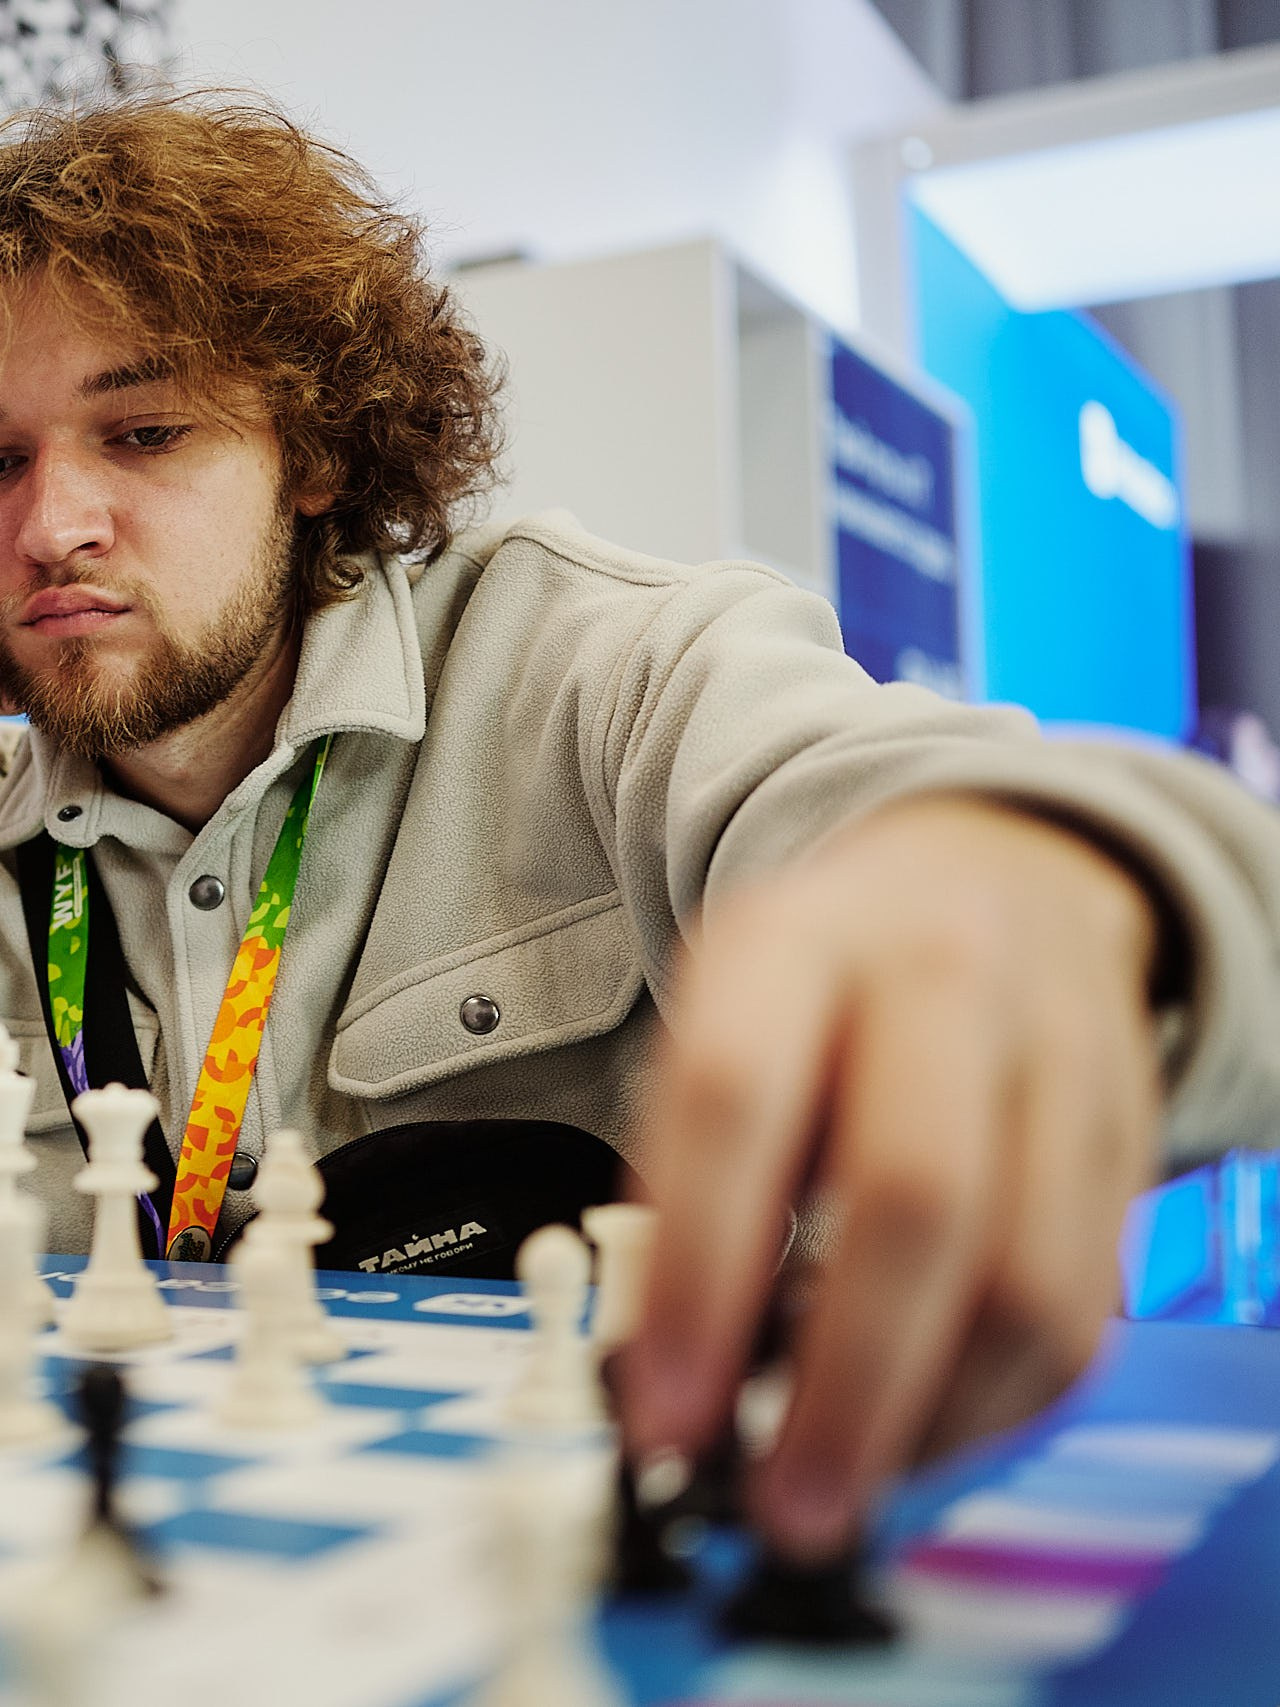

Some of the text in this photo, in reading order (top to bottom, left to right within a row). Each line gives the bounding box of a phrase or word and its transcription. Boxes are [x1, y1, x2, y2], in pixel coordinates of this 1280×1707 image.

[358, 1221, 487, 1273] ТАЙНА
[419, 1256, 434, 1264] НЕ
[434, 1242, 473, 1260] ГОВОРИ
